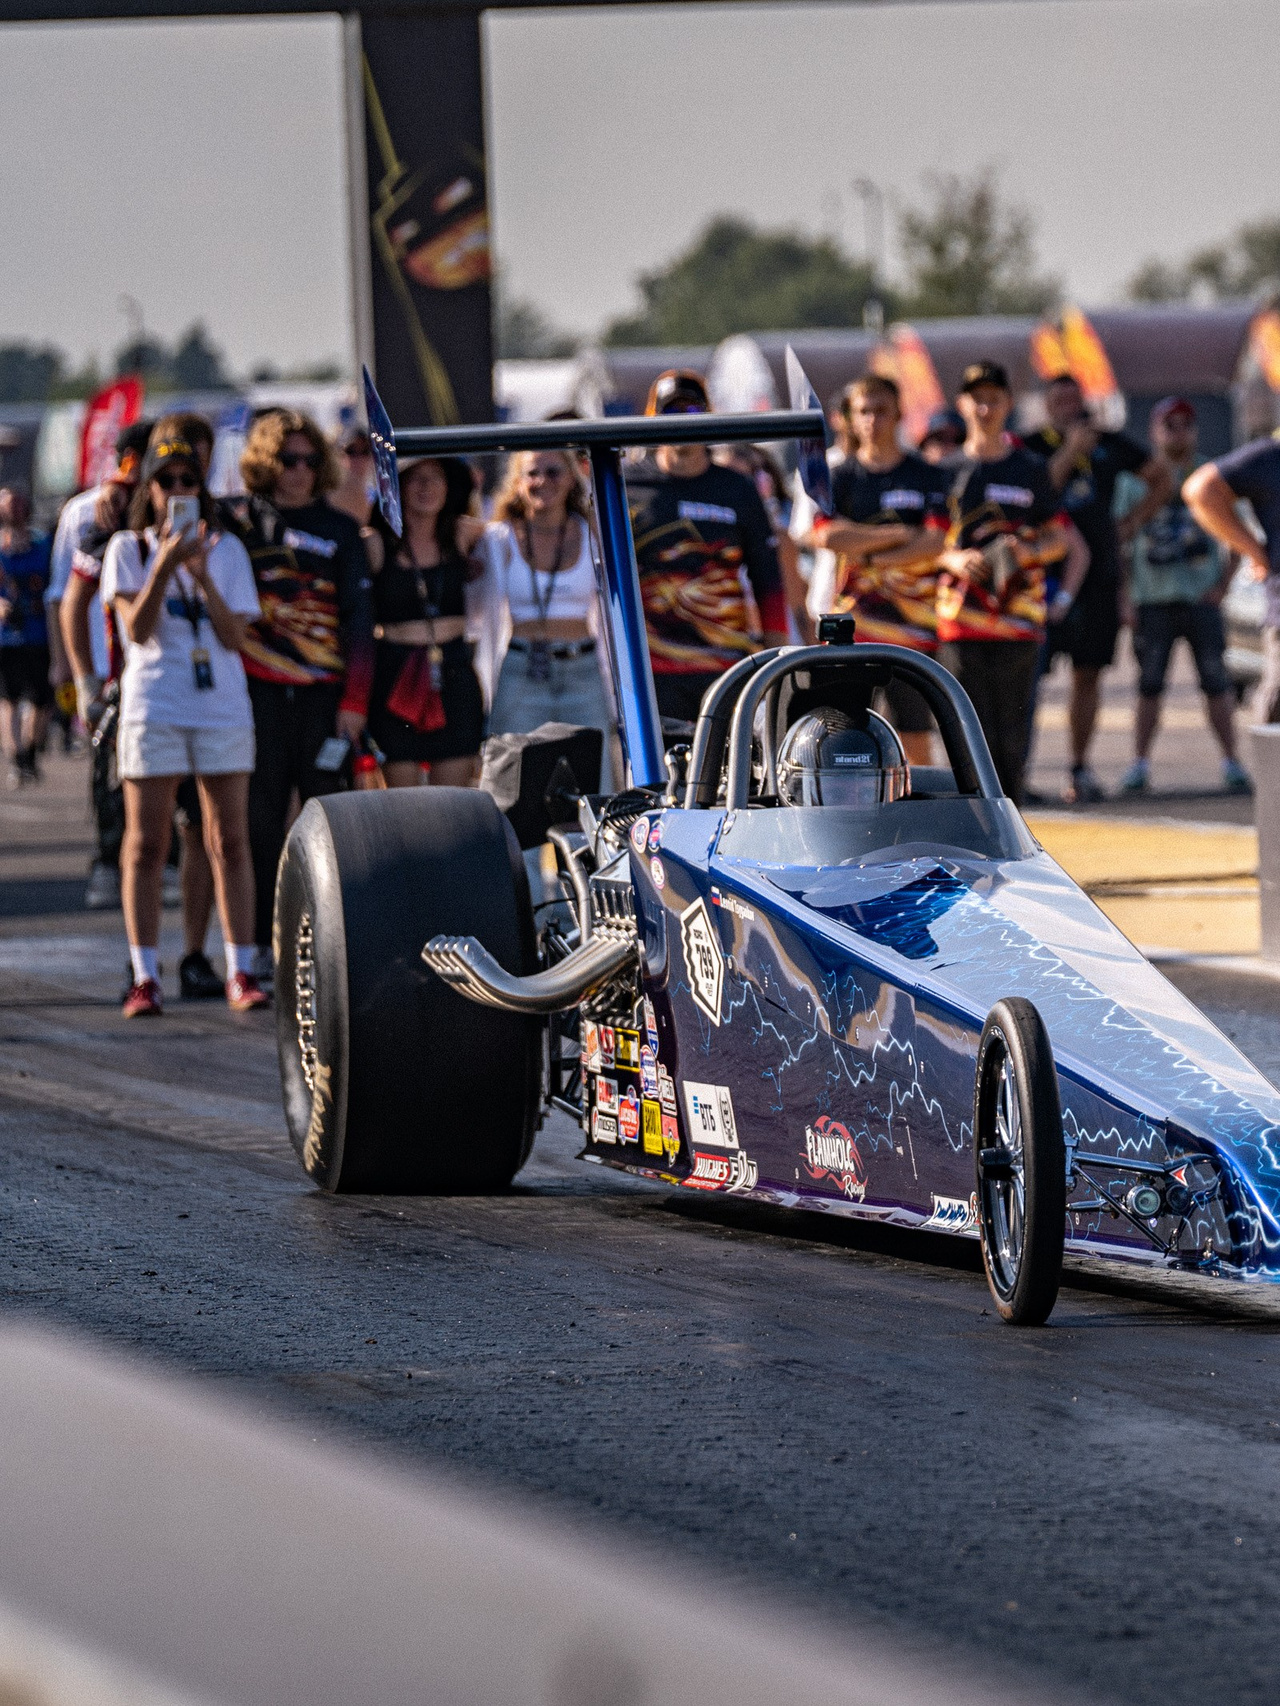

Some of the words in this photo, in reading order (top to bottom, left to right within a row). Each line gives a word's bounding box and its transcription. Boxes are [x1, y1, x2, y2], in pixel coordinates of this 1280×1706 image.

[695, 943, 715, 980] 799
[693, 1156, 729, 1180] HUGHES
[843, 1174, 866, 1204] Racing
